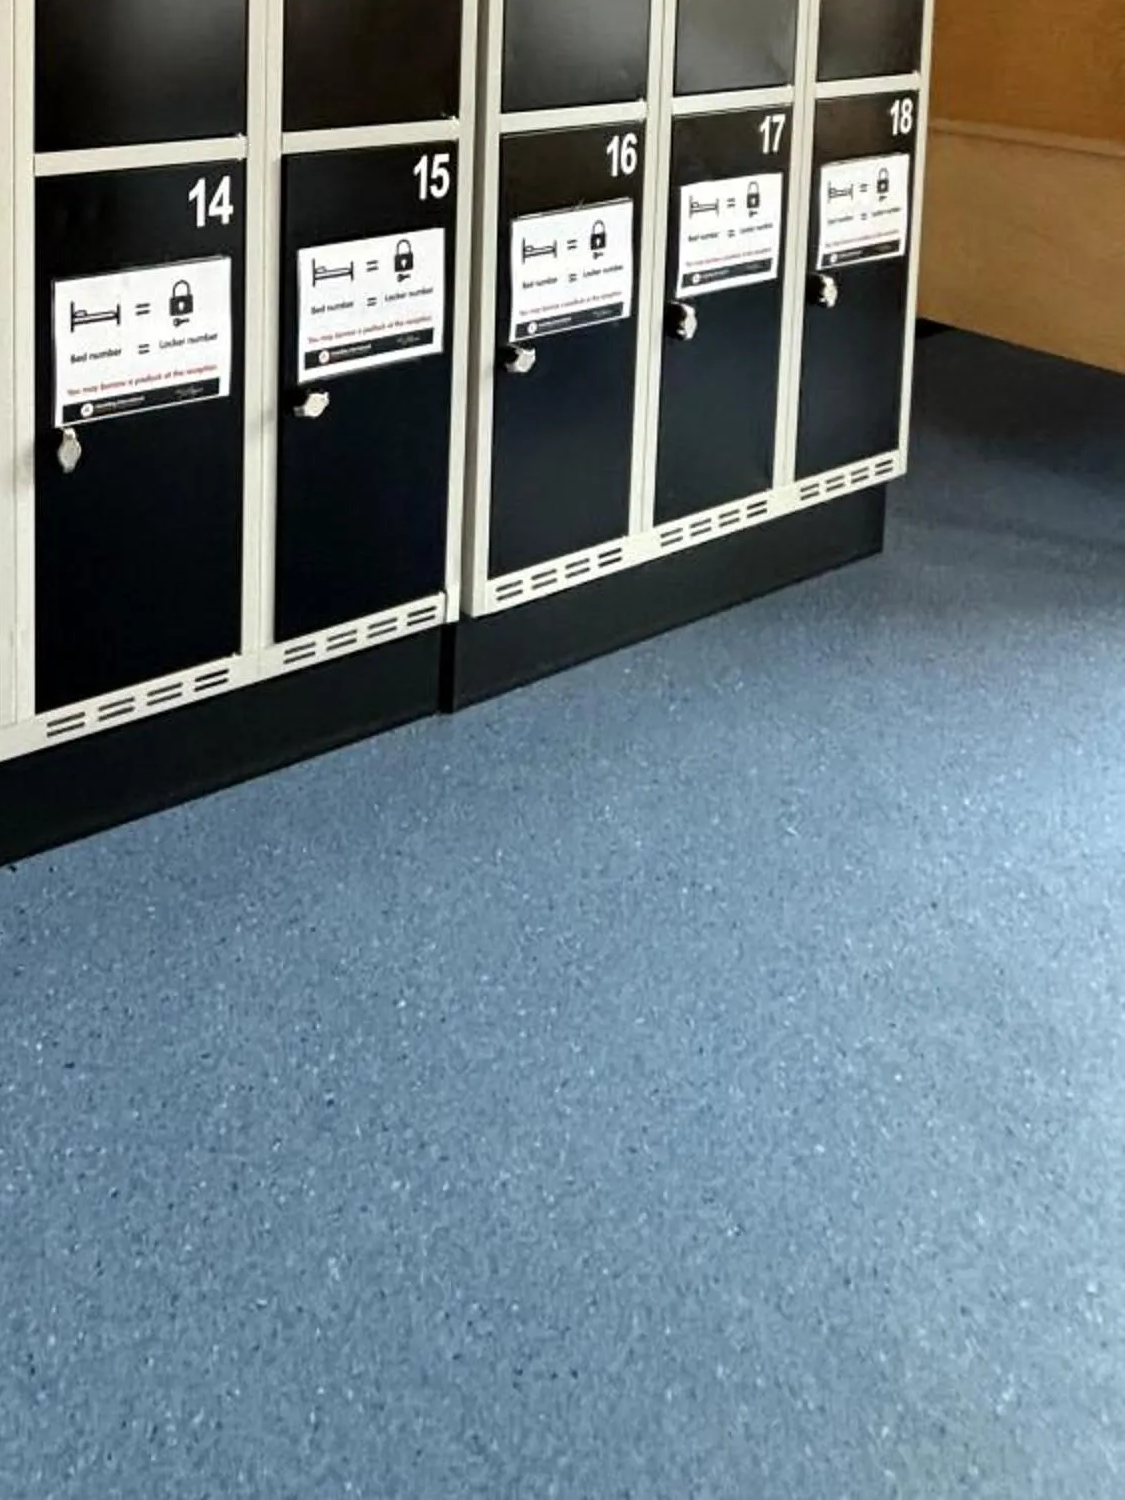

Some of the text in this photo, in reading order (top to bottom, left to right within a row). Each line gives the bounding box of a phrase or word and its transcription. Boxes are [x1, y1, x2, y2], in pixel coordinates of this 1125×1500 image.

[759, 113, 786, 154] 17
[890, 98, 913, 136] 18
[606, 132, 638, 177] 16
[413, 153, 450, 200] 15
[188, 175, 234, 227] 14
[70, 352, 86, 363] Bed
[89, 346, 121, 360] number
[158, 336, 184, 349] Locker
[187, 331, 217, 344] number
